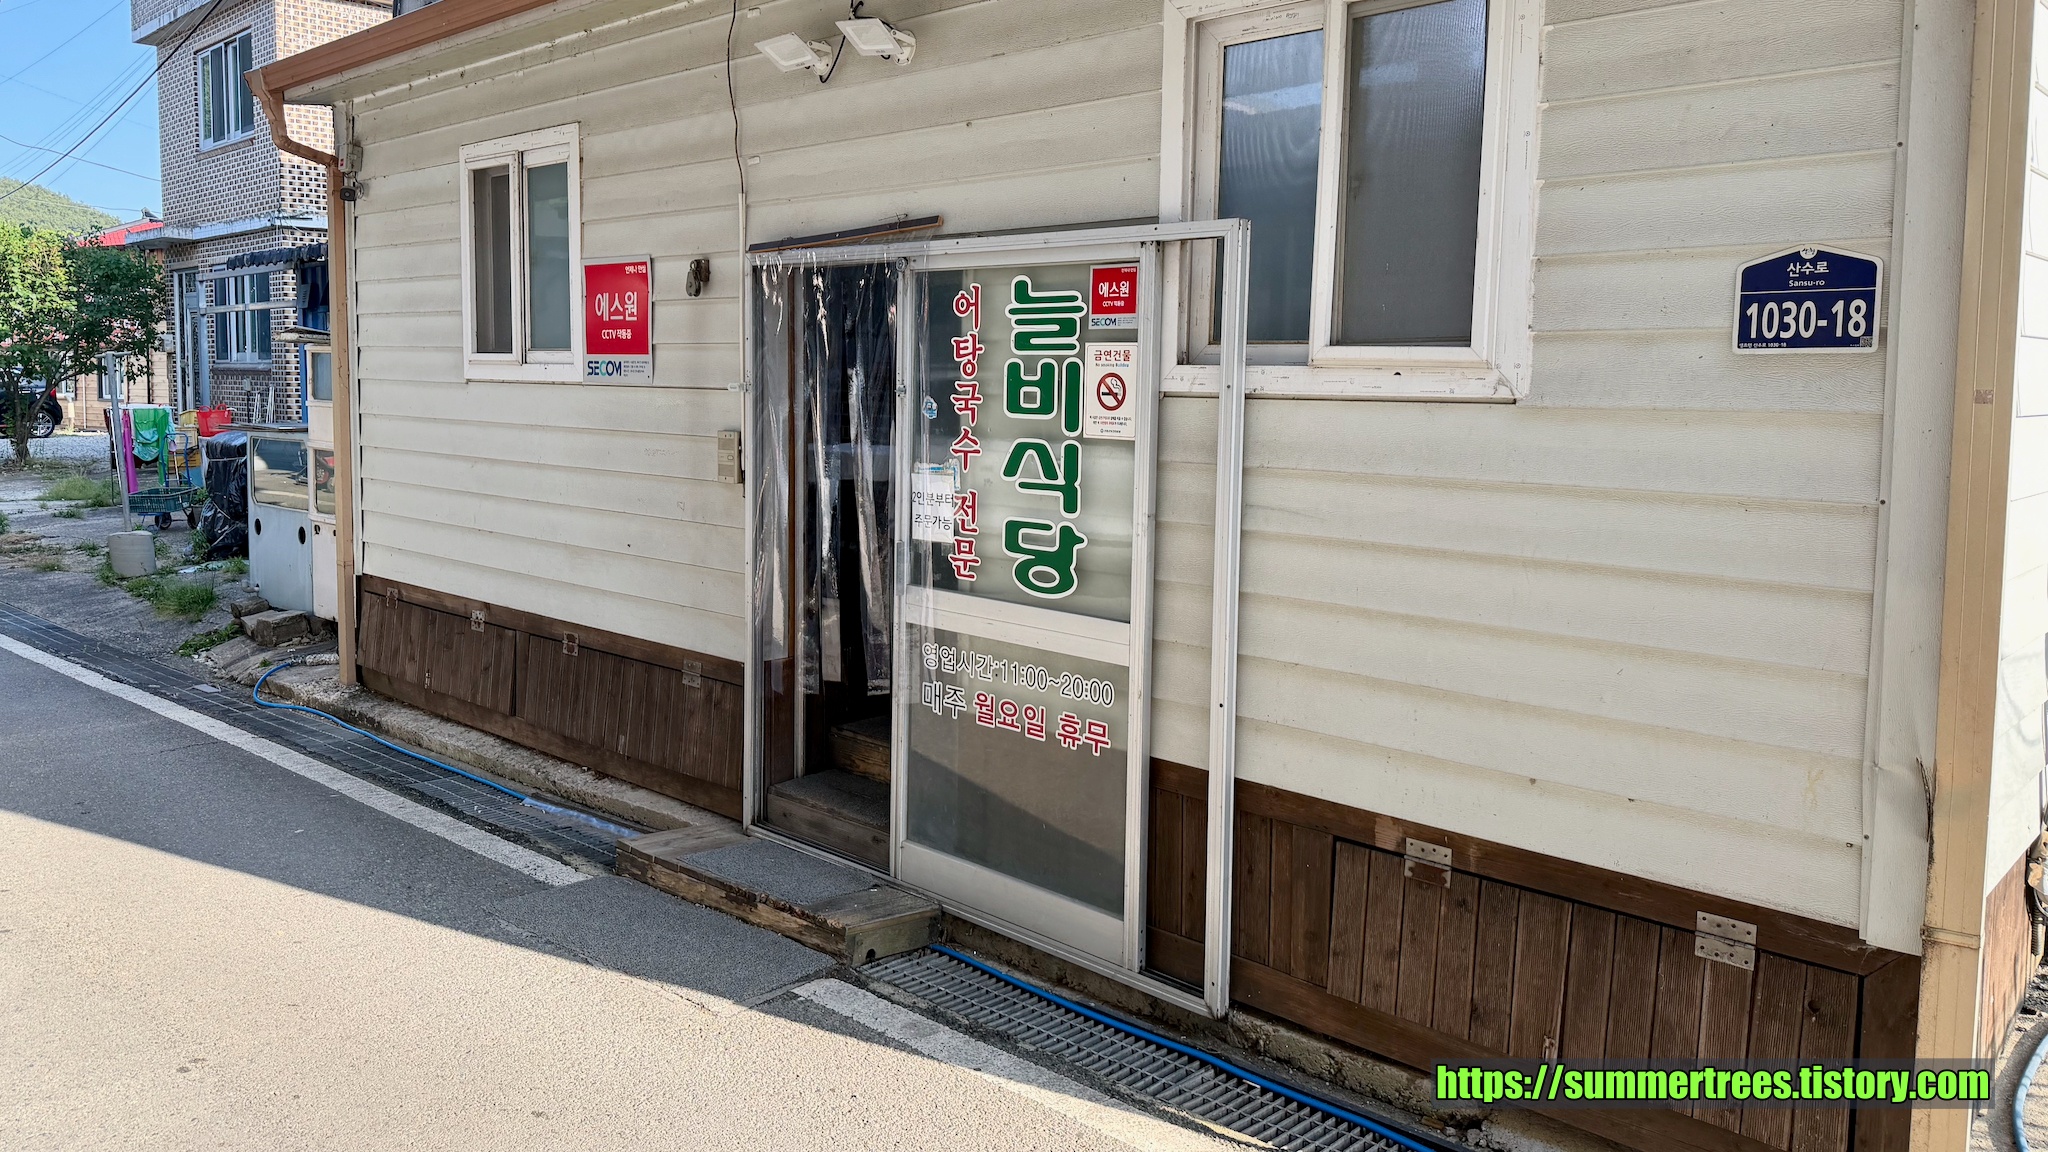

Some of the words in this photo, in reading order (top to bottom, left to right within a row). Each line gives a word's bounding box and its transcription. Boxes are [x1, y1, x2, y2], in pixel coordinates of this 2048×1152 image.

[1786, 261, 1830, 278] 산수로
[1098, 280, 1130, 298] 에스원
[1788, 279, 1826, 288] Sansu-ro
[595, 291, 638, 321] 에스원
[1091, 317, 1117, 327] SECOM
[1746, 298, 1868, 340] 1030-18
[601, 329, 617, 340] CCTV
[617, 328, 632, 340] 작동중
[1094, 349, 1132, 362] 금연건물
[587, 360, 622, 377] SECOM
[951, 283, 985, 474] 어탕국수
[1001, 274, 1088, 599] 늘비식당
[911, 491, 954, 508] 2인분부터
[914, 513, 953, 531] 주문가능
[949, 489, 981, 581] 전문
[922, 680, 967, 719] 매주
[973, 690, 1046, 742] 월요일
[1055, 710, 1111, 756] 휴무
